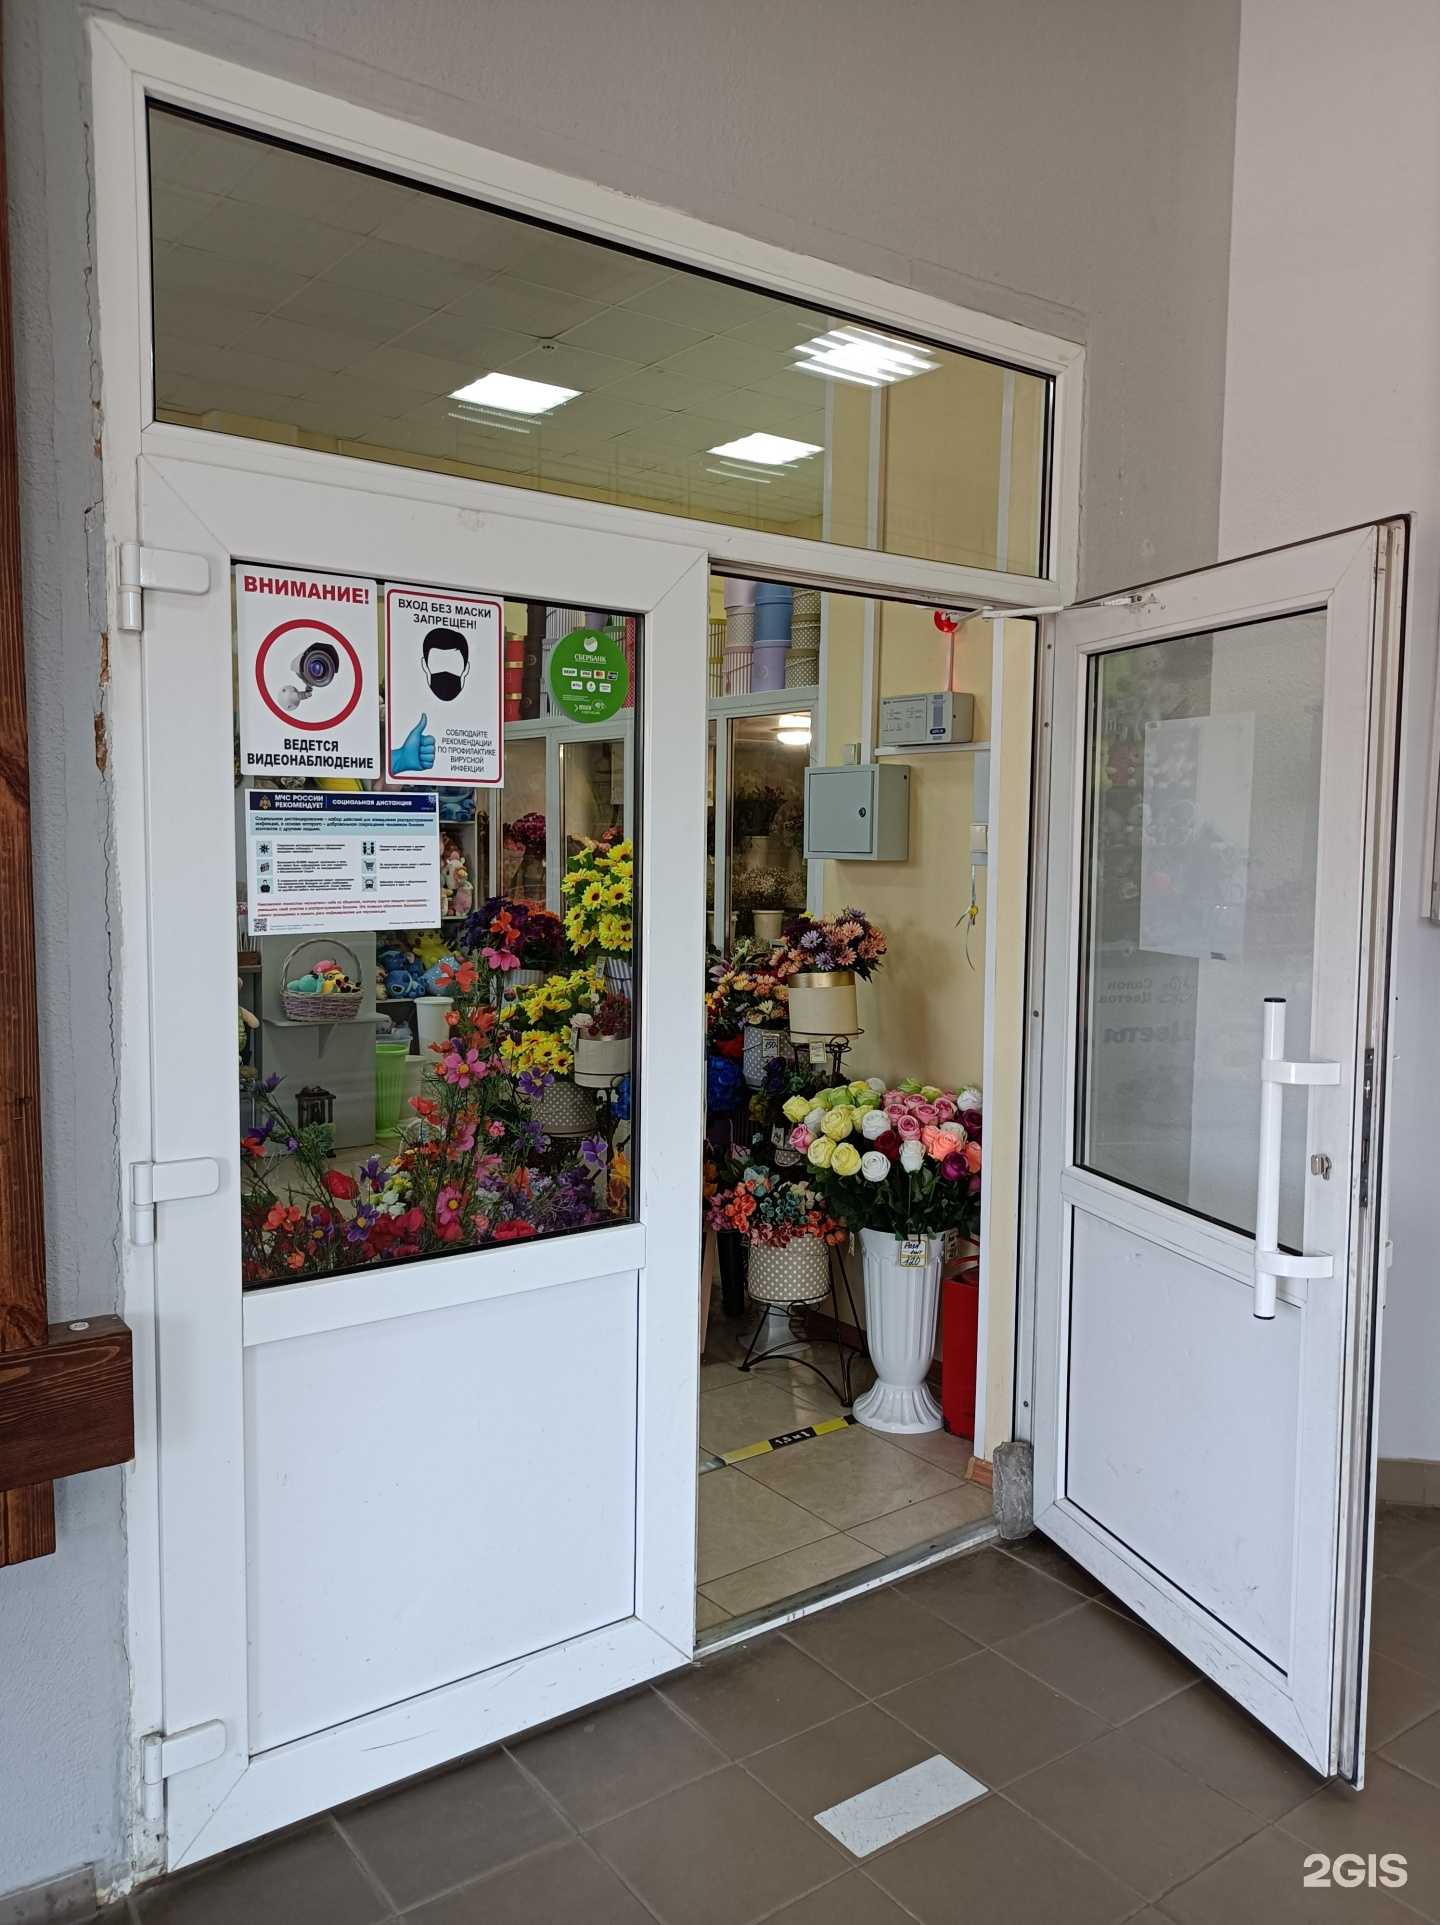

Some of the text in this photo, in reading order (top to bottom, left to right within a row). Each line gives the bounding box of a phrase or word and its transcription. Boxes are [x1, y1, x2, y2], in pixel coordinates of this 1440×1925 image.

[244, 575, 370, 604] ВНИМАНИЕ!
[398, 598, 492, 619] ВХОД БЕЗ МАСКИ
[413, 613, 477, 630] ЗАПРЕЩЕН!
[445, 729, 489, 738] СОБЛЮДАЙТЕ
[284, 738, 339, 754] ВЕДЕТСЯ
[442, 737, 493, 747] РЕКОМЕНДАЦИИ
[437, 745, 496, 756] ПО ПРОФИЛАКТИКЕ
[247, 752, 374, 770] ВИДЕОНАБЛЮДЕНИЕ
[450, 755, 484, 765] ВИРУСНОЙ
[450, 763, 485, 773] ИНФЕКЦИИ
[275, 801, 323, 809] РЕКОМЕНДУЕТ
